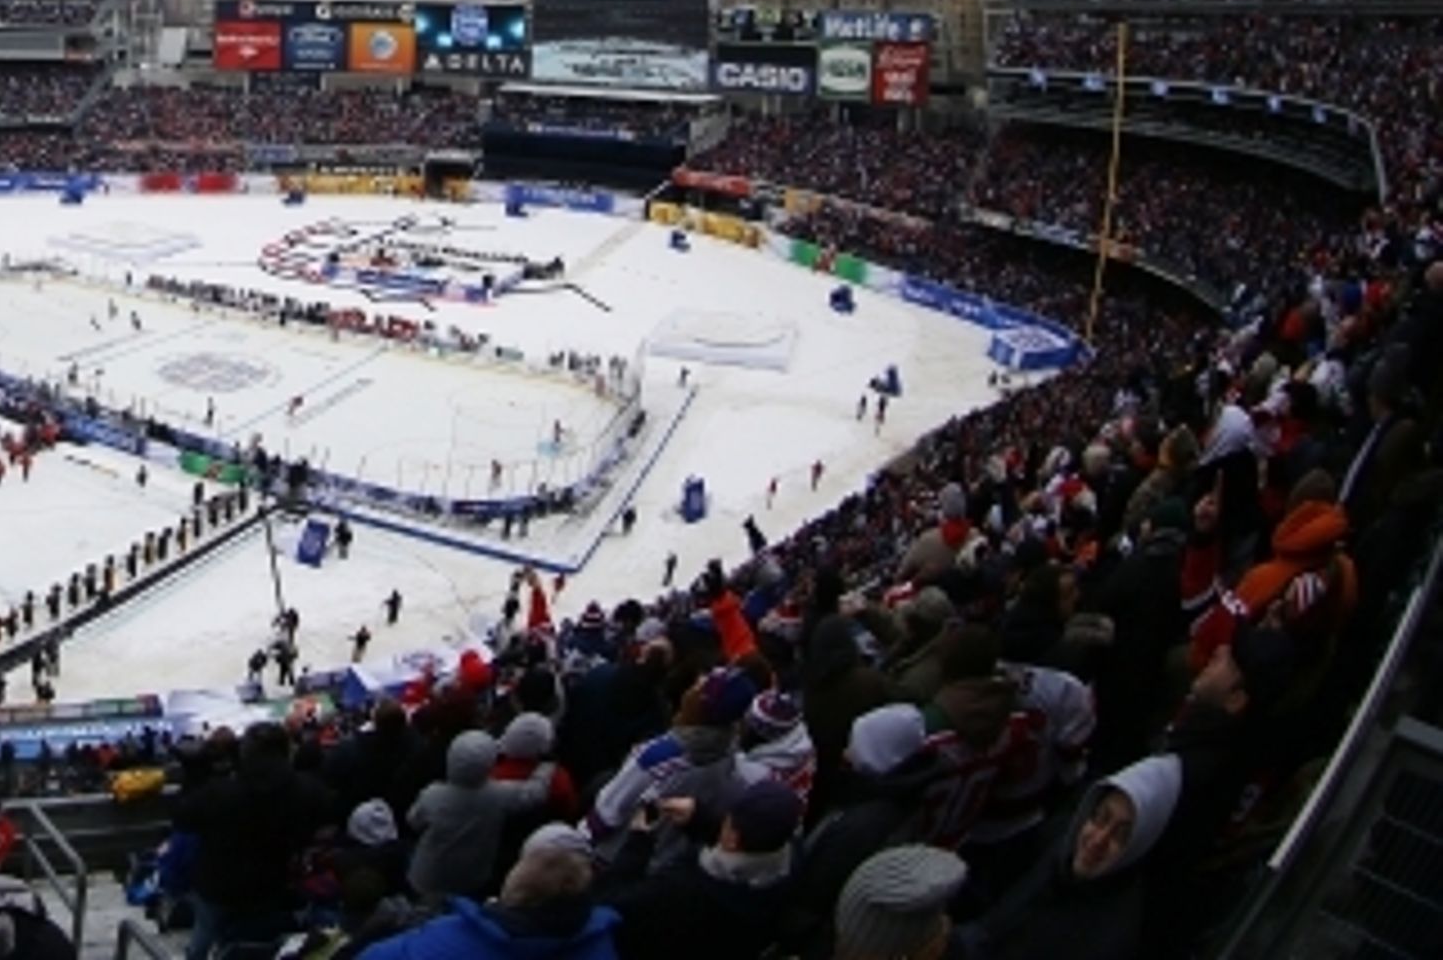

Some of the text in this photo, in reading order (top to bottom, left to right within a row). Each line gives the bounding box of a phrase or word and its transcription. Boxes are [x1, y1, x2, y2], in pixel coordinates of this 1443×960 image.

[824, 13, 900, 39] MetLife
[446, 53, 525, 74] DELTA
[717, 62, 807, 91] CASIO
